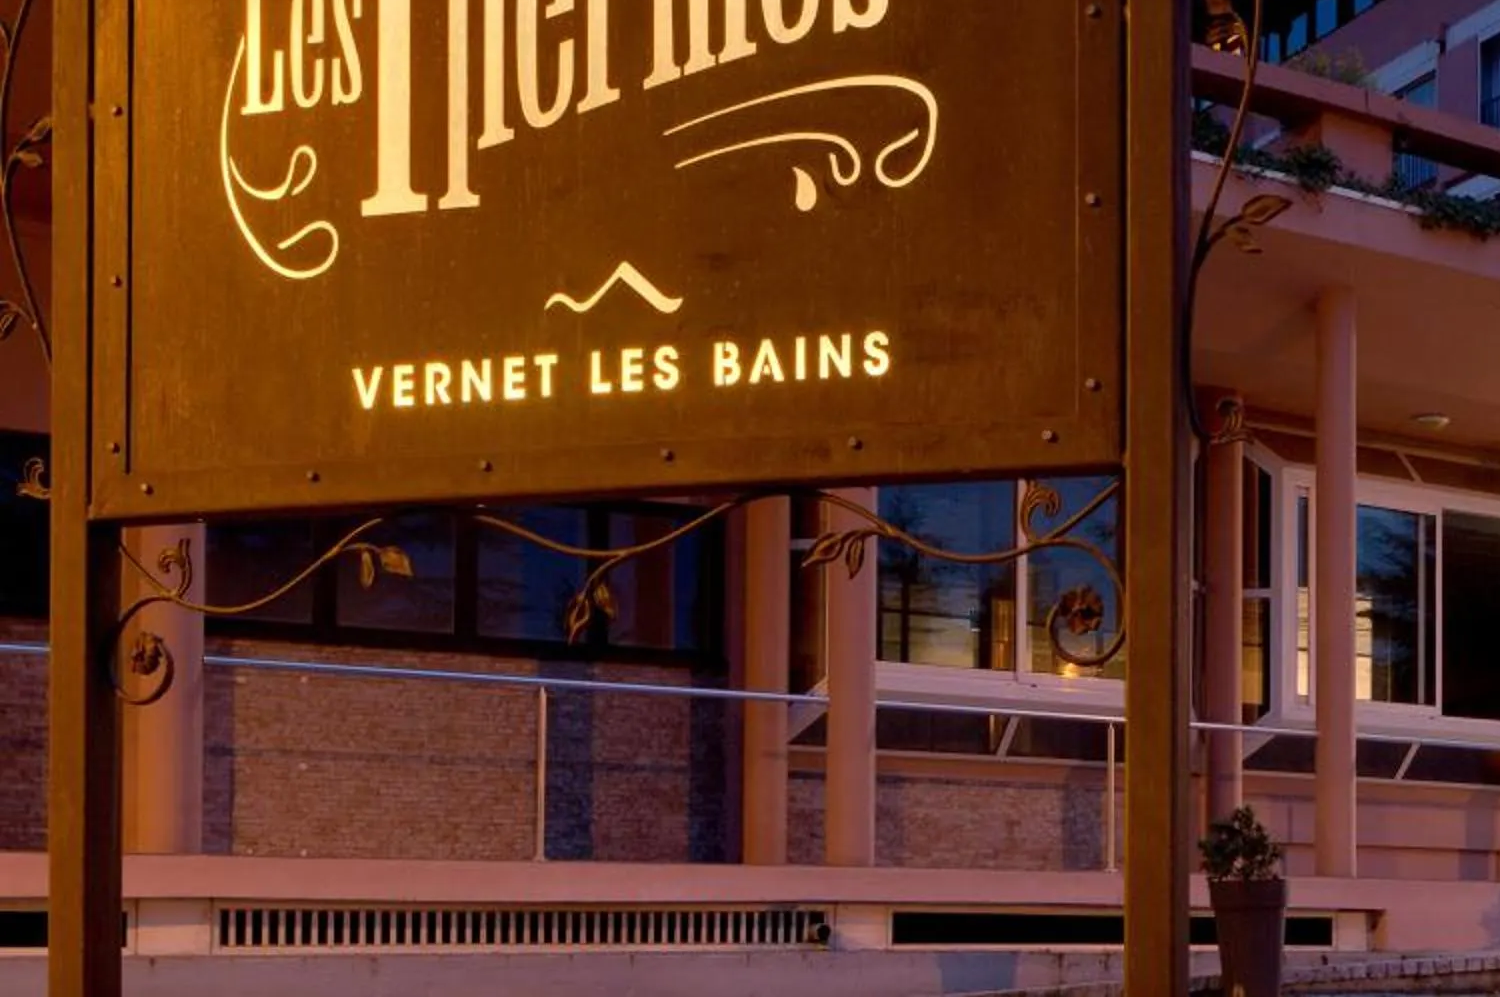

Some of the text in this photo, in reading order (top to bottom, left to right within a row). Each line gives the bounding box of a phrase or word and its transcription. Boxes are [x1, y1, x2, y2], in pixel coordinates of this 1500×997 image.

[351, 329, 890, 411] VERNET LES BAINS
